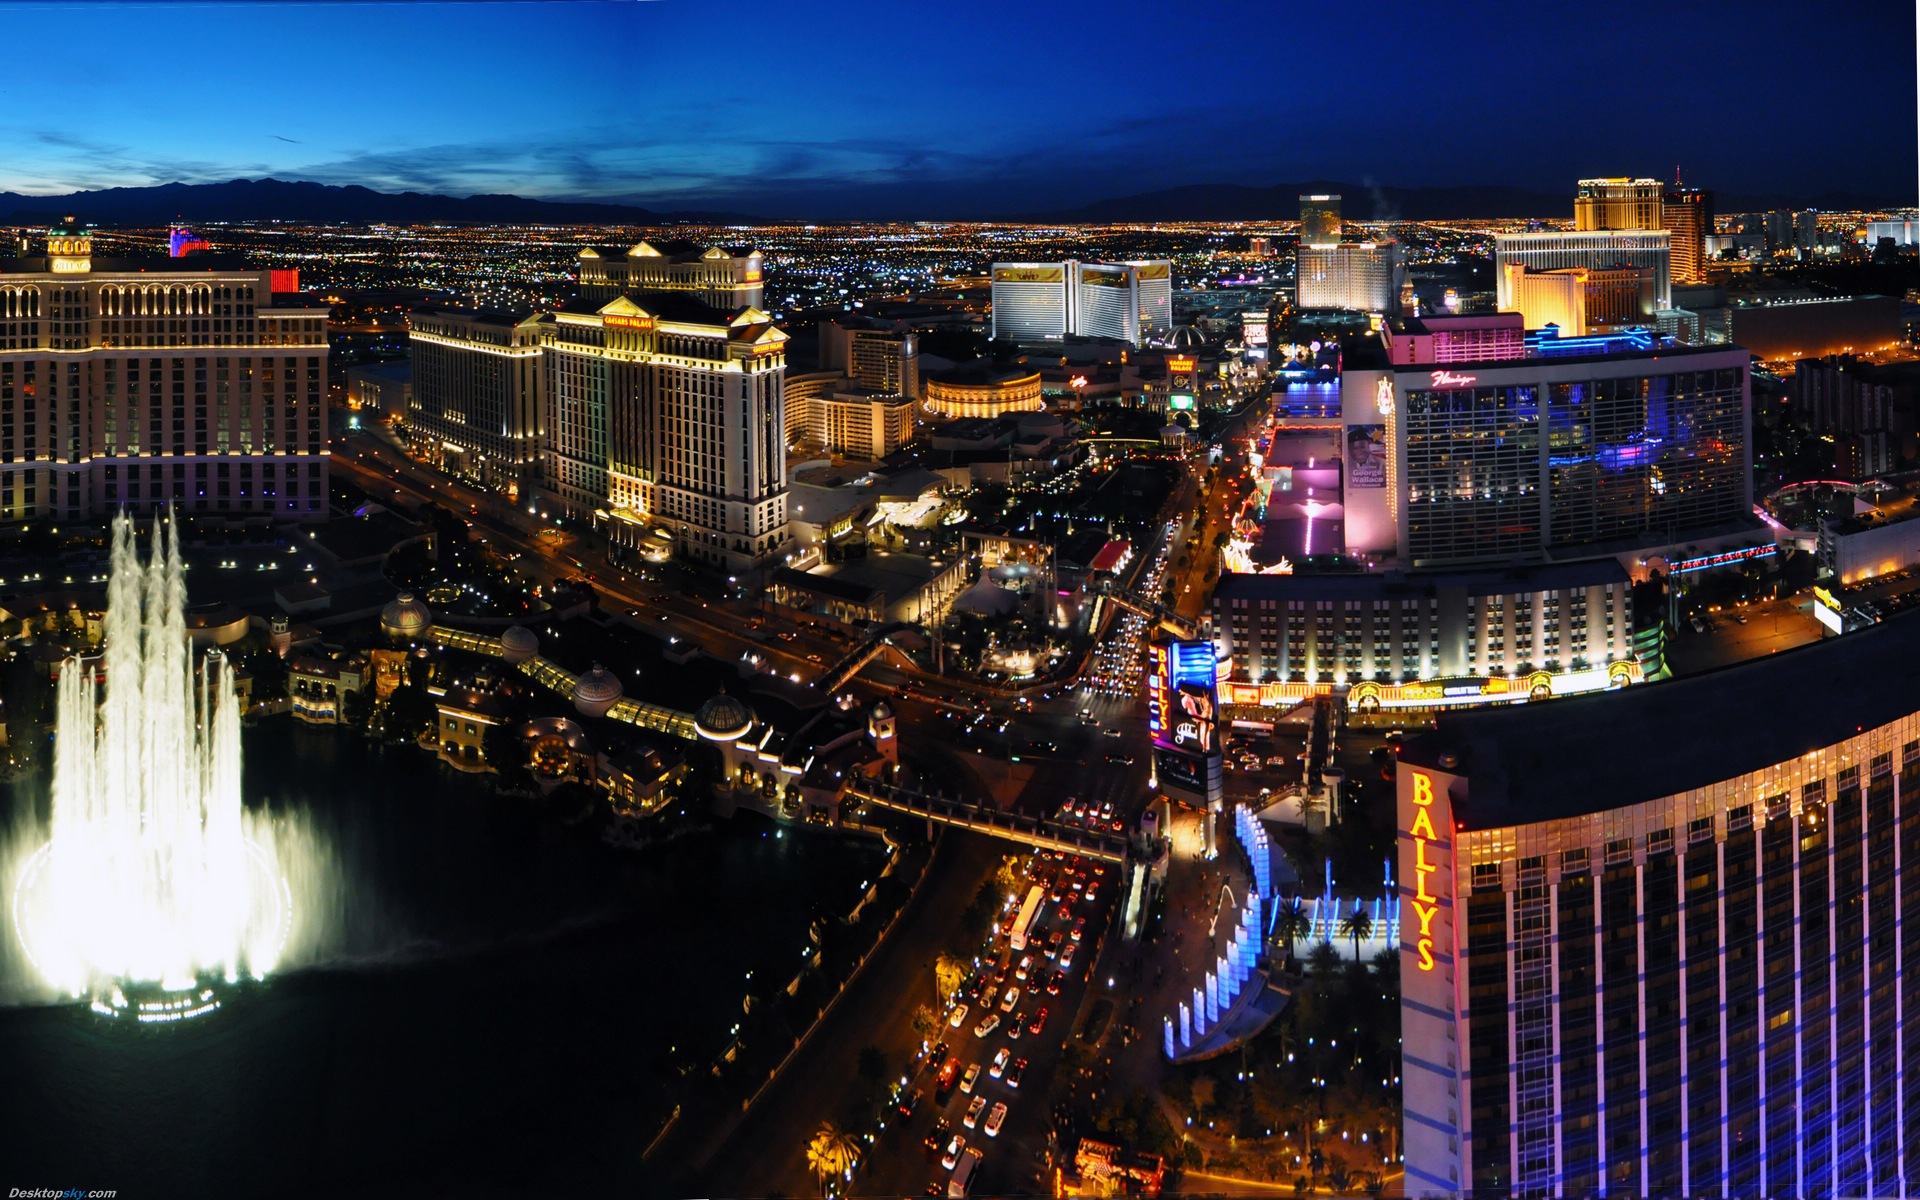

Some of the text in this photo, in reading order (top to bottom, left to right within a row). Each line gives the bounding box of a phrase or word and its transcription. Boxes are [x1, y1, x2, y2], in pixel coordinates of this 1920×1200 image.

[605, 316, 652, 328] CAESARS PALACE
[1431, 370, 1476, 387] Flamingo
[1352, 469, 1382, 477] George
[1157, 648, 1168, 731] BALLYS
[1410, 771, 1439, 972] BALLYS
